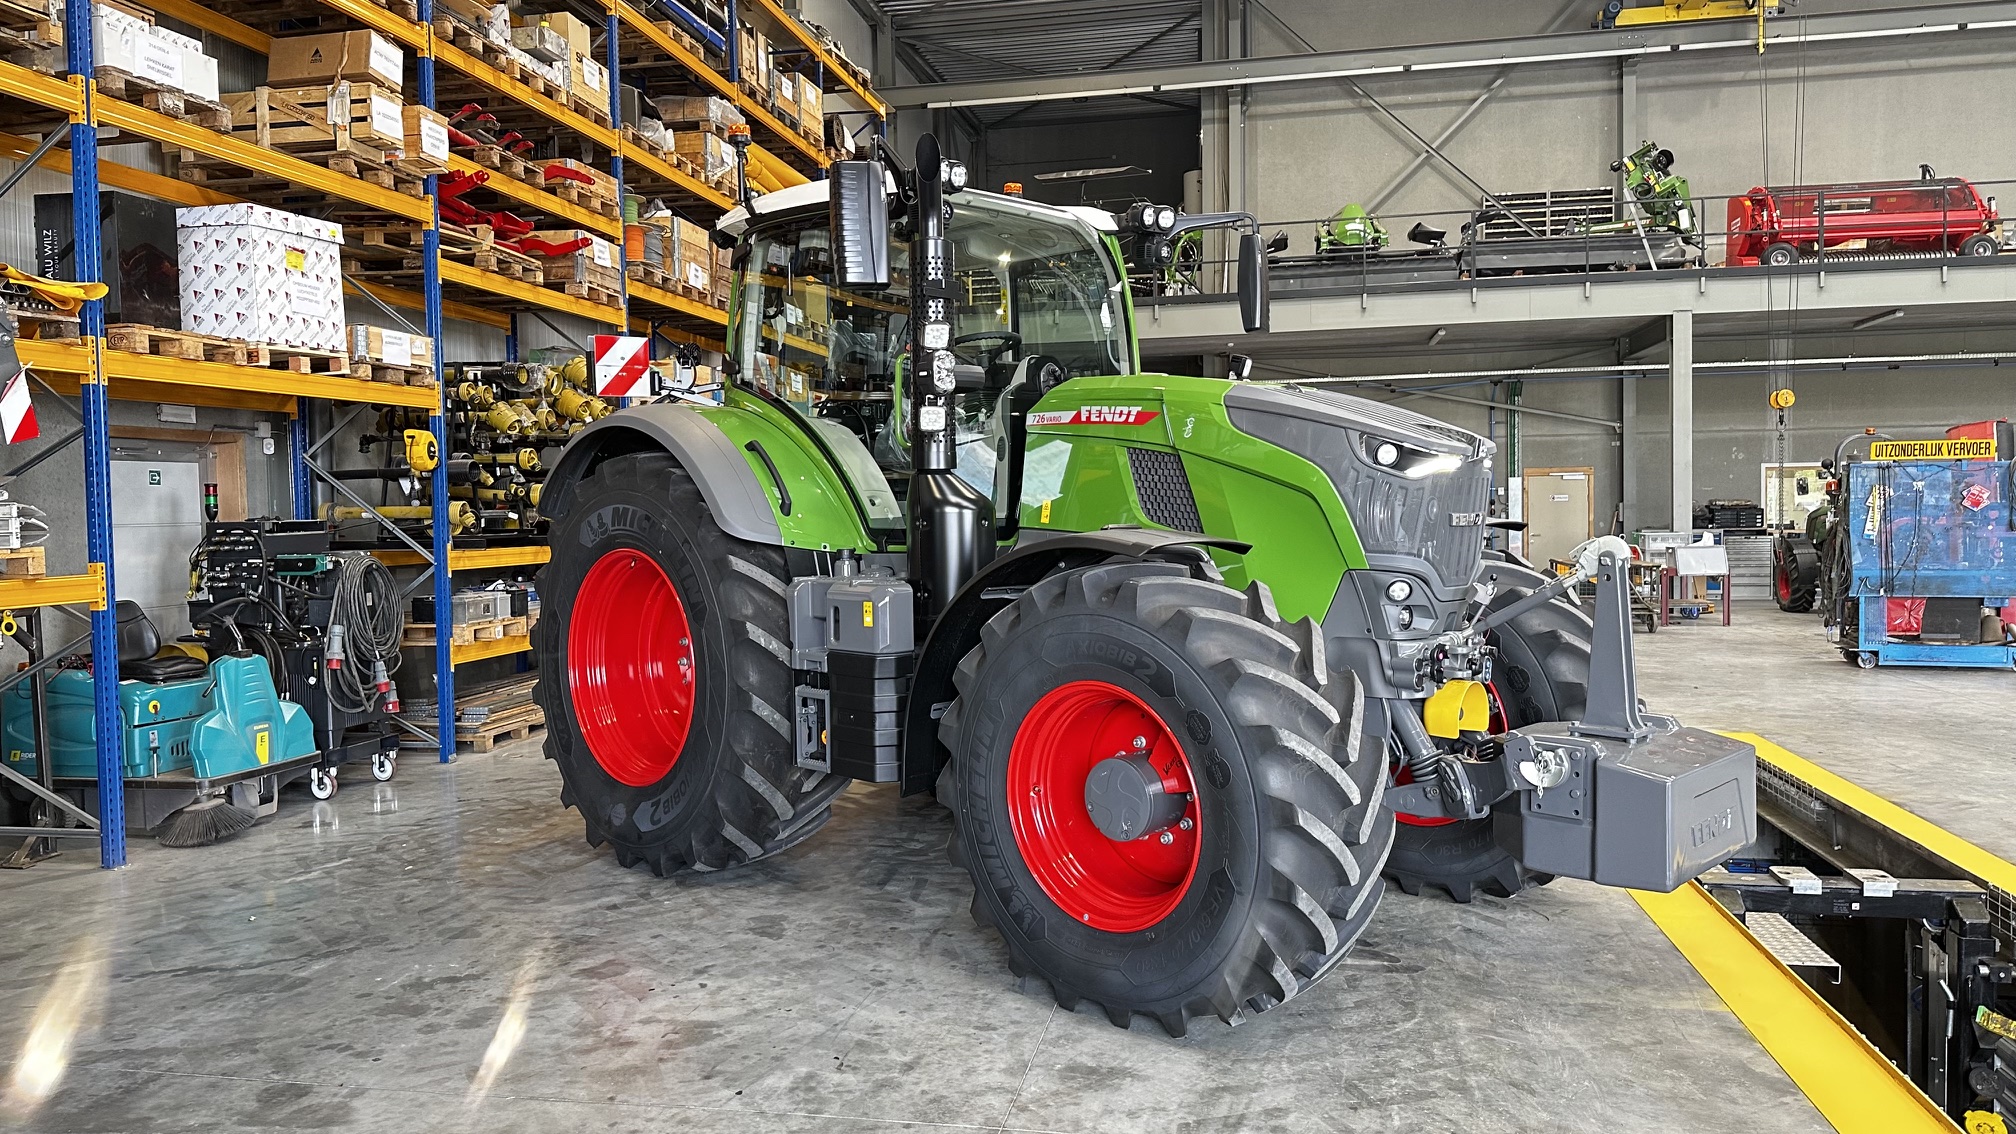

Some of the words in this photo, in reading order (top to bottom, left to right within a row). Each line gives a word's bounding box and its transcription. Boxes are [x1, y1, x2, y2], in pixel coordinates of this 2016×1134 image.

[1032, 414, 1046, 424] 726
[1045, 415, 1062, 423] VARIO
[1080, 405, 1142, 423] FENDT
[1874, 443, 1944, 458] UITZONDERLIJK
[1946, 441, 1991, 456] VERVOER
[1133, 655, 1158, 684] 2
[968, 708, 1014, 891] MICHELIN
[649, 797, 662, 827] 2
